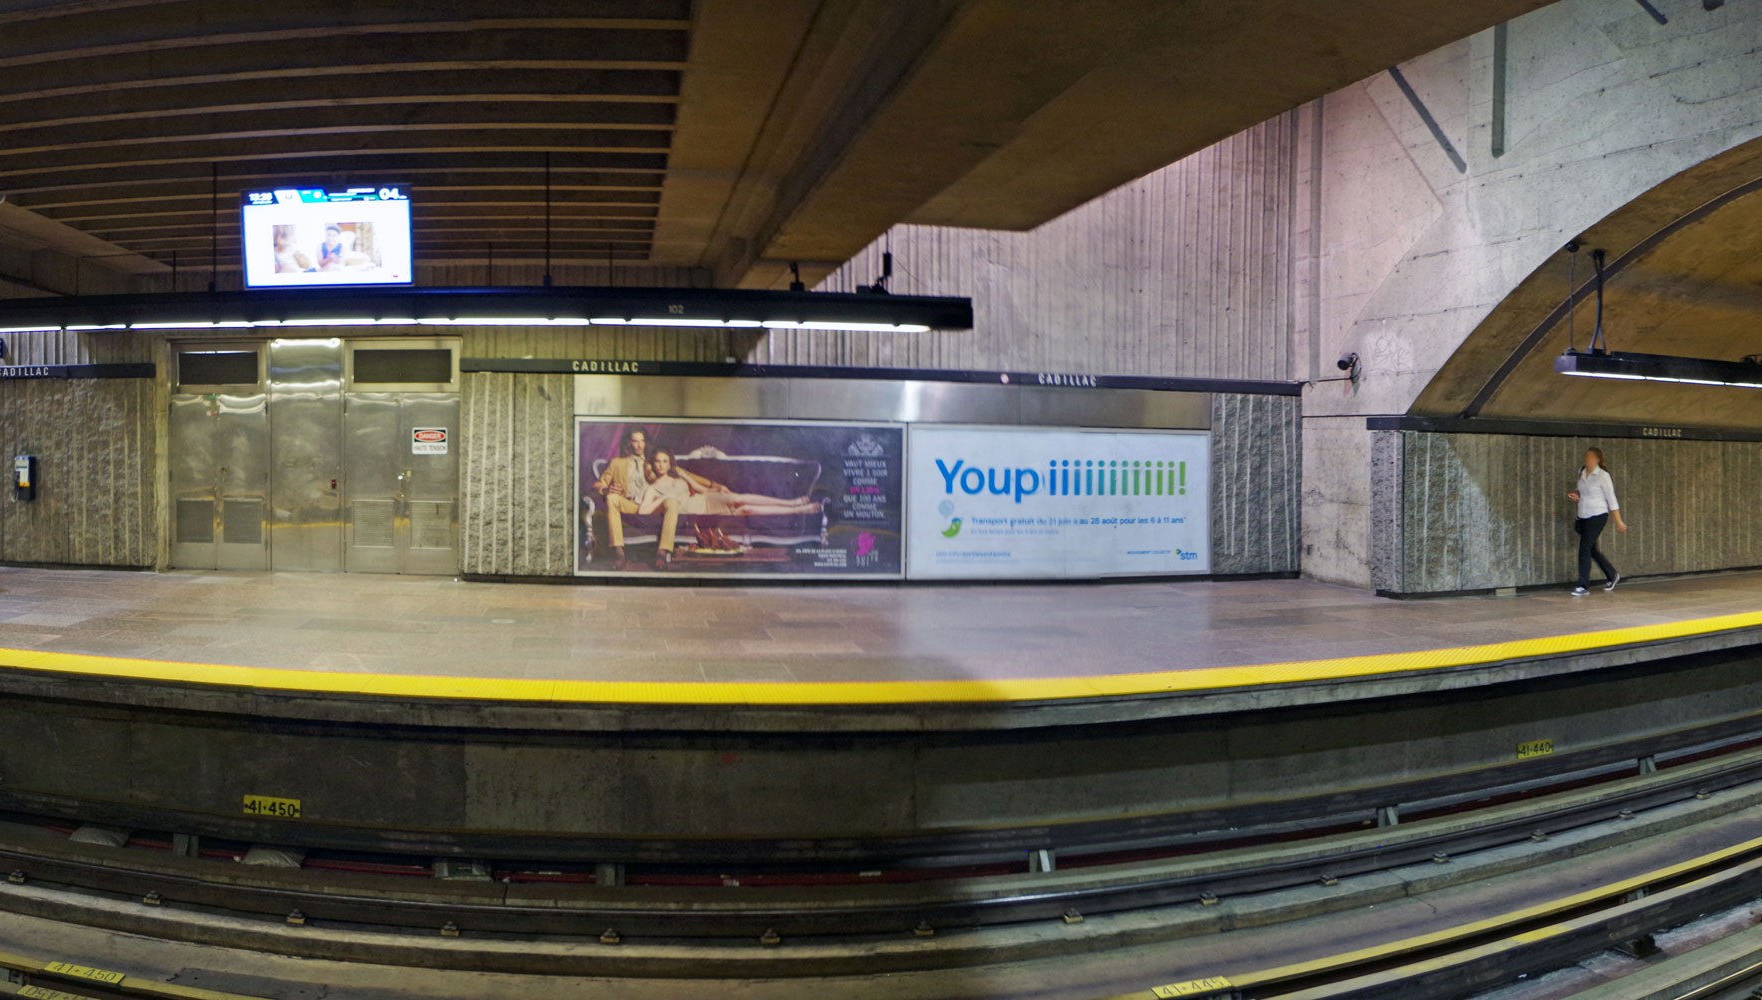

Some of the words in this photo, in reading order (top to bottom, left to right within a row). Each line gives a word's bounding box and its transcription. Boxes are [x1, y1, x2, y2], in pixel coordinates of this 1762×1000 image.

[572, 361, 639, 372] CADILLAC
[1038, 372, 1097, 388] CADILLAC
[1642, 427, 1682, 438] CADILLAC
[1180, 551, 1198, 561] stm
